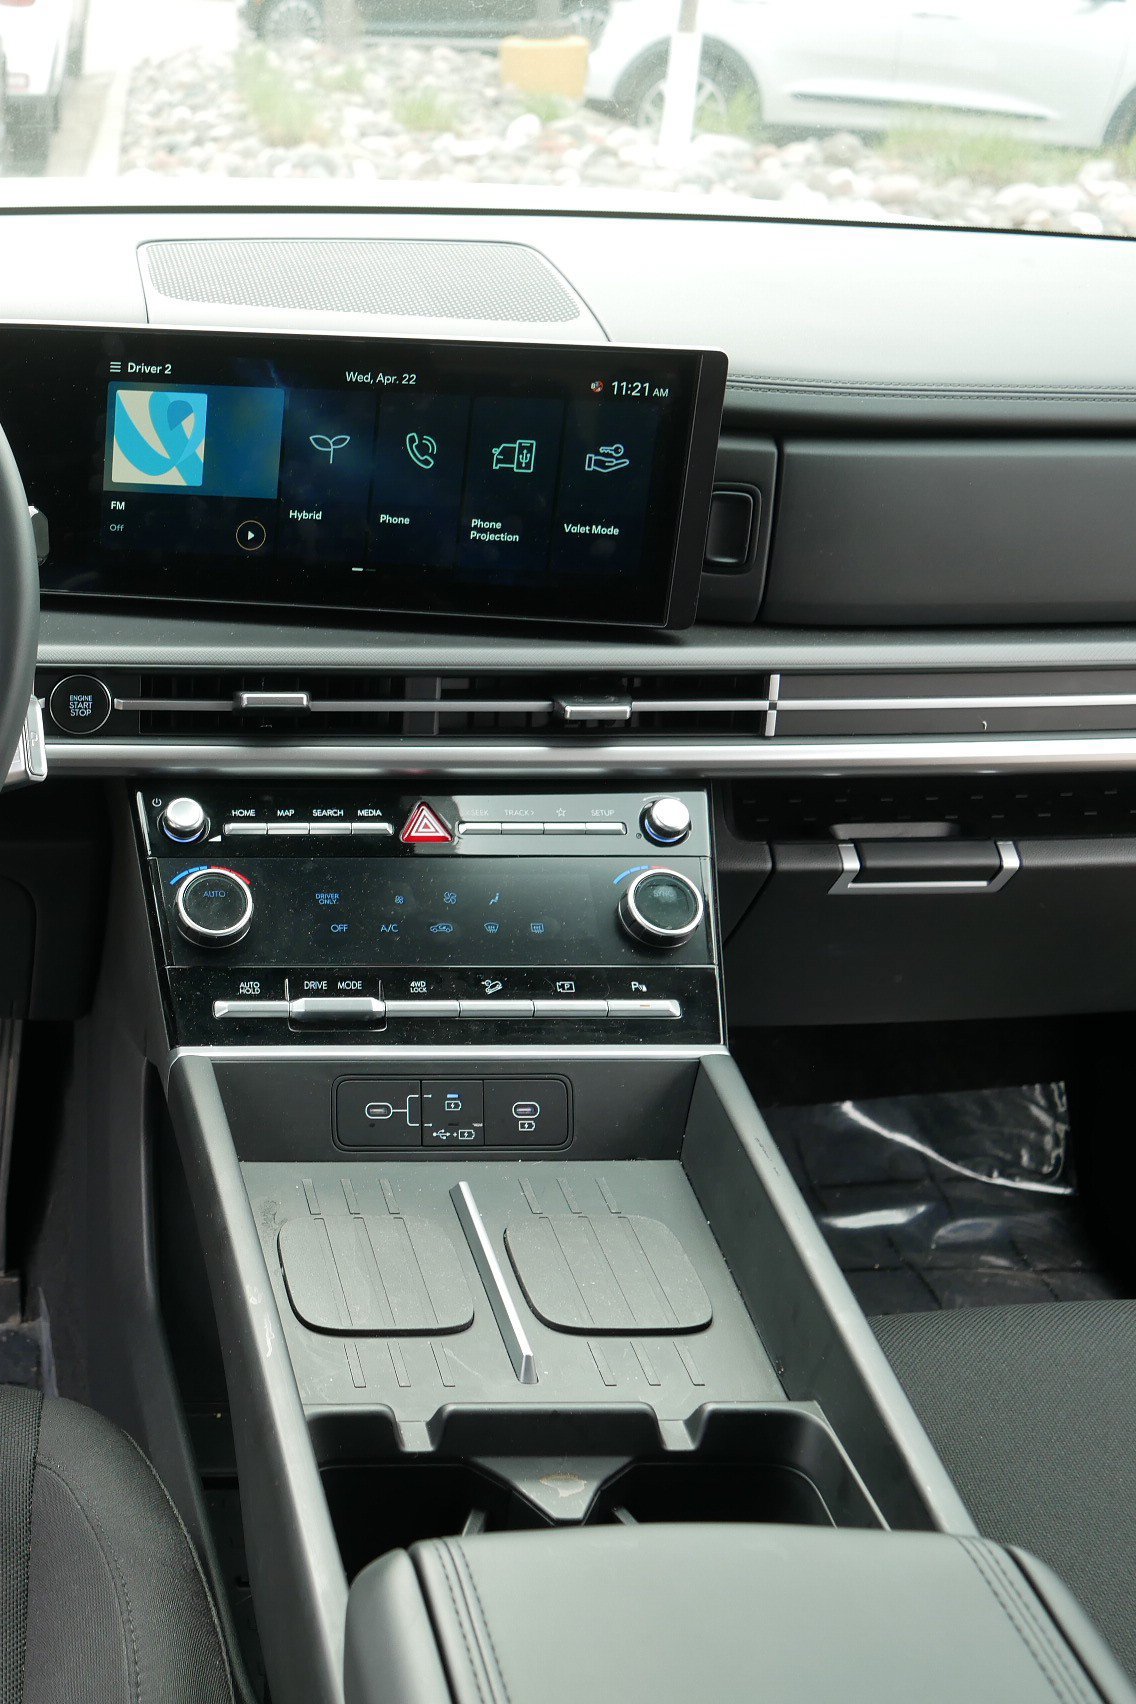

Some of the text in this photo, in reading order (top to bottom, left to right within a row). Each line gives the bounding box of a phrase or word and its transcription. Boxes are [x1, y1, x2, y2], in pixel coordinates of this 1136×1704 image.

[127, 362, 172, 374] Driver 2
[345, 371, 417, 385] Wed, Apr. 22
[611, 381, 650, 397] 11:21
[652, 388, 669, 397] AM
[110, 501, 125, 510] FM
[289, 510, 322, 521] Hybrid
[379, 514, 410, 525] Phone
[109, 524, 124, 532] Off
[471, 519, 502, 529] Phone
[563, 523, 619, 536] Valet Mode
[469, 531, 519, 543] Projection
[69, 694, 93, 702] ENGINE
[69, 701, 93, 709] START
[70, 709, 92, 717] STOP
[231, 809, 256, 817] HOME
[277, 809, 295, 817] MAP
[312, 809, 344, 817] SEARCH
[357, 809, 382, 817] MEDIA
[591, 808, 614, 817] SETUP
[203, 890, 226, 898] AUTO
[331, 924, 349, 932] OFF
[380, 923, 399, 933] A/C
[304, 981, 362, 990] DRIVE MODE
